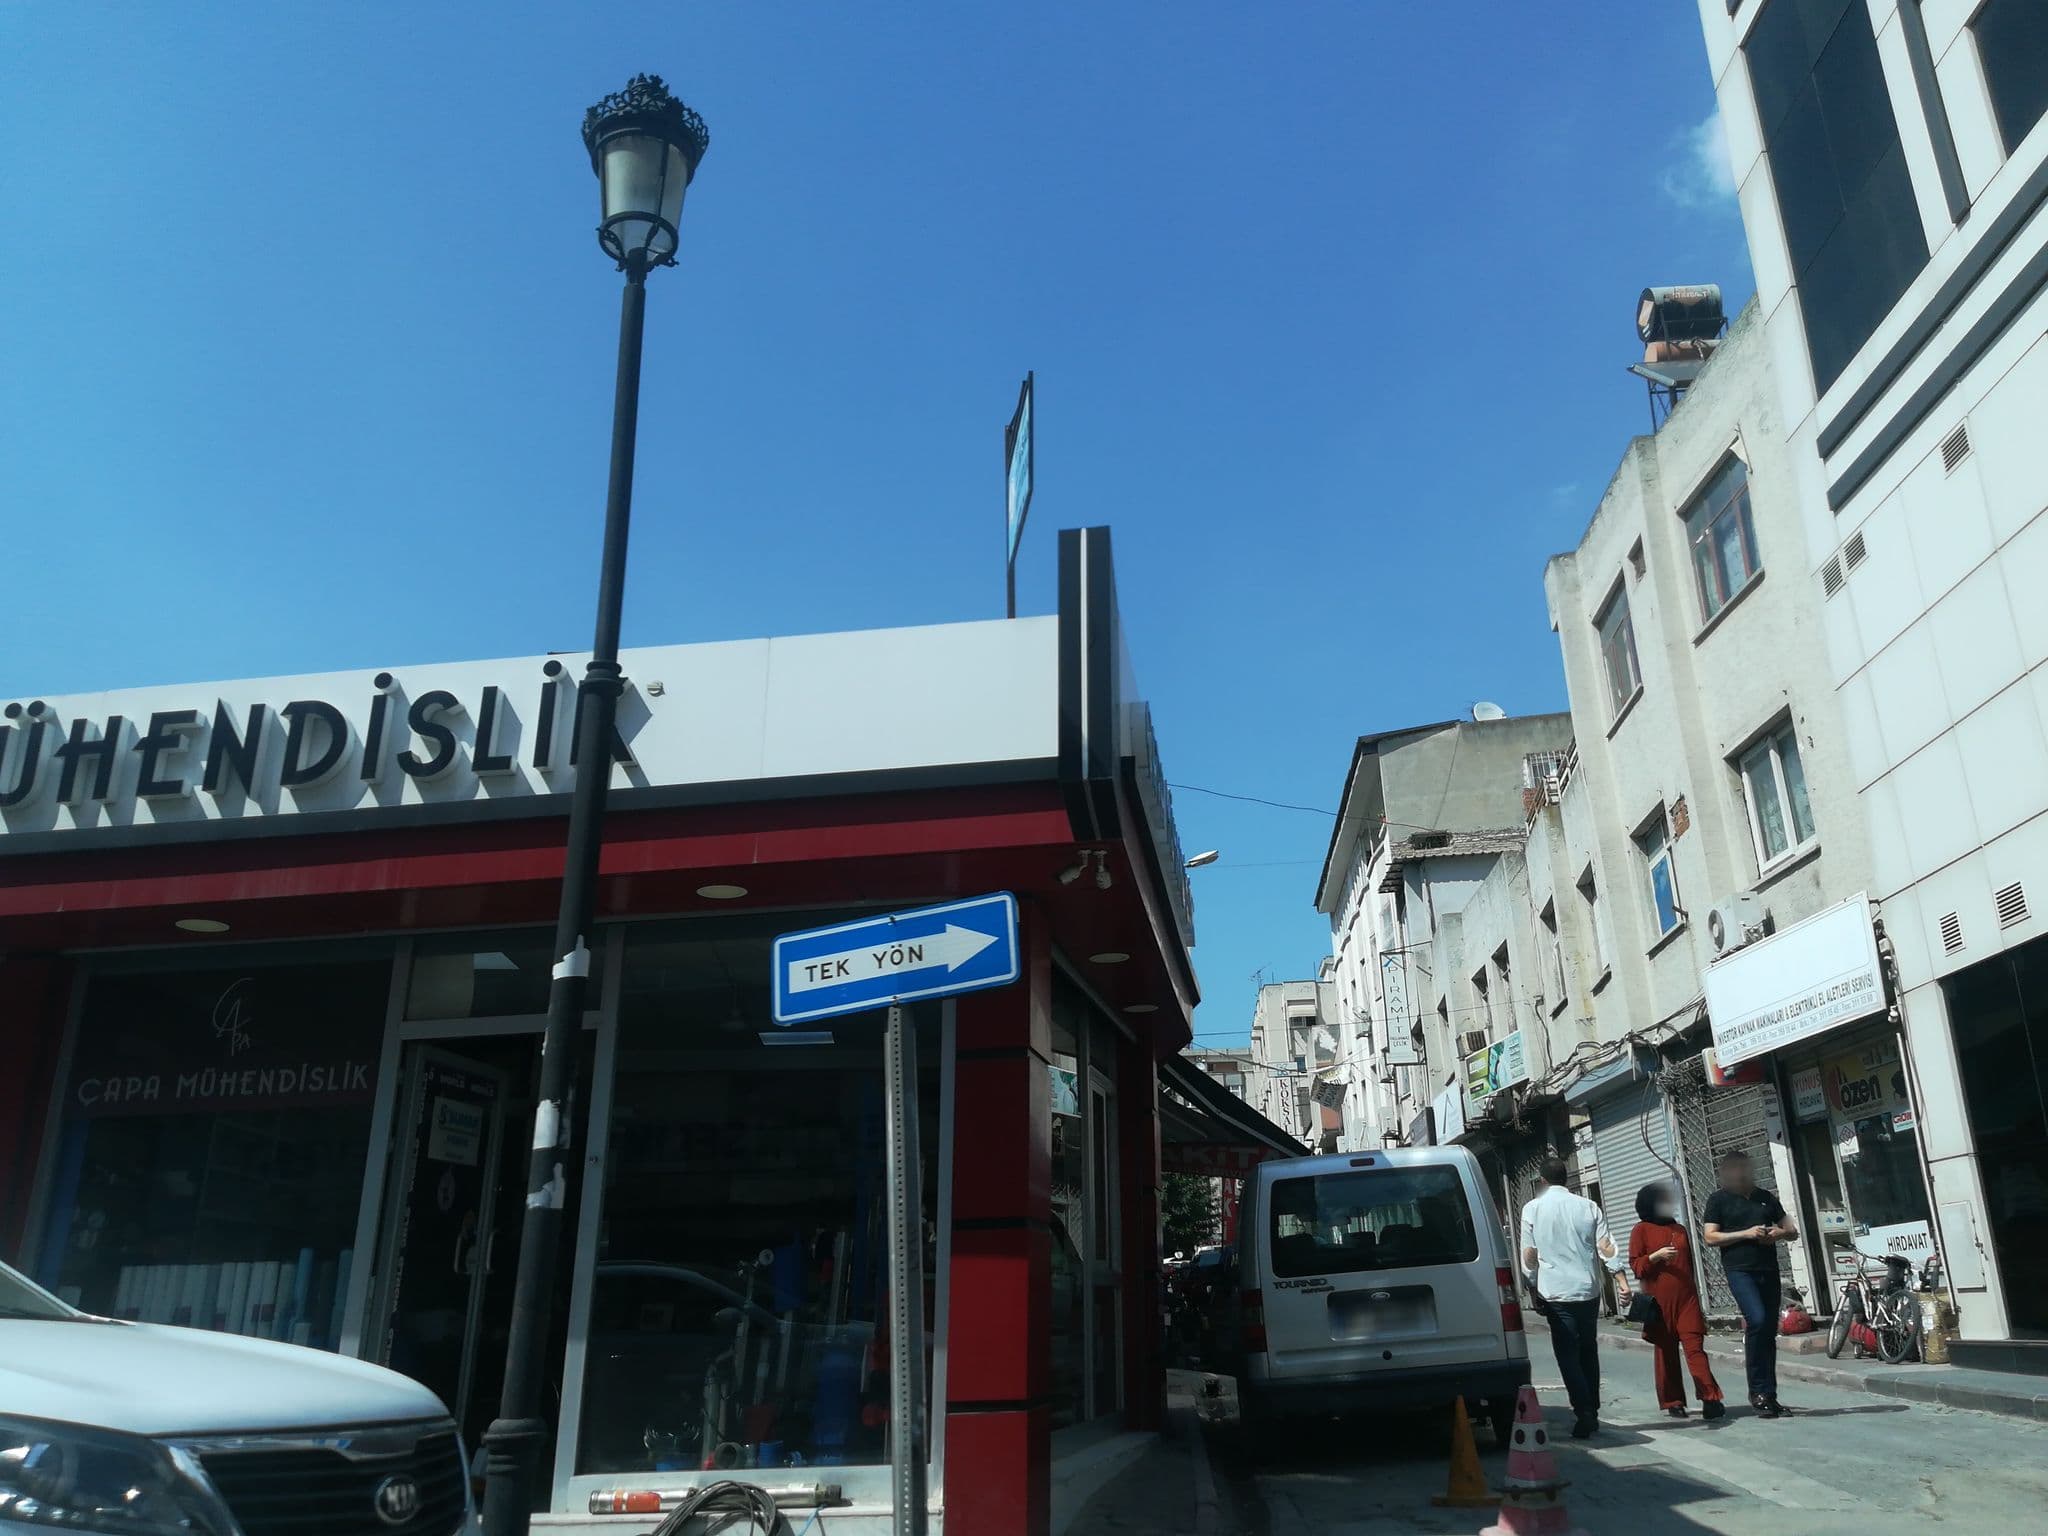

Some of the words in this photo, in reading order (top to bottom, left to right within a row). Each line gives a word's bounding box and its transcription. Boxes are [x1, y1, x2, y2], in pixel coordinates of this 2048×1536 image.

[805, 959, 850, 983] TEK
[872, 944, 924, 969] YÖN
[78, 1075, 161, 1106] ÇAPA
[176, 1060, 369, 1098] MÜHENDİSLİK
[1887, 1233, 1928, 1253] HIRDAVAT
